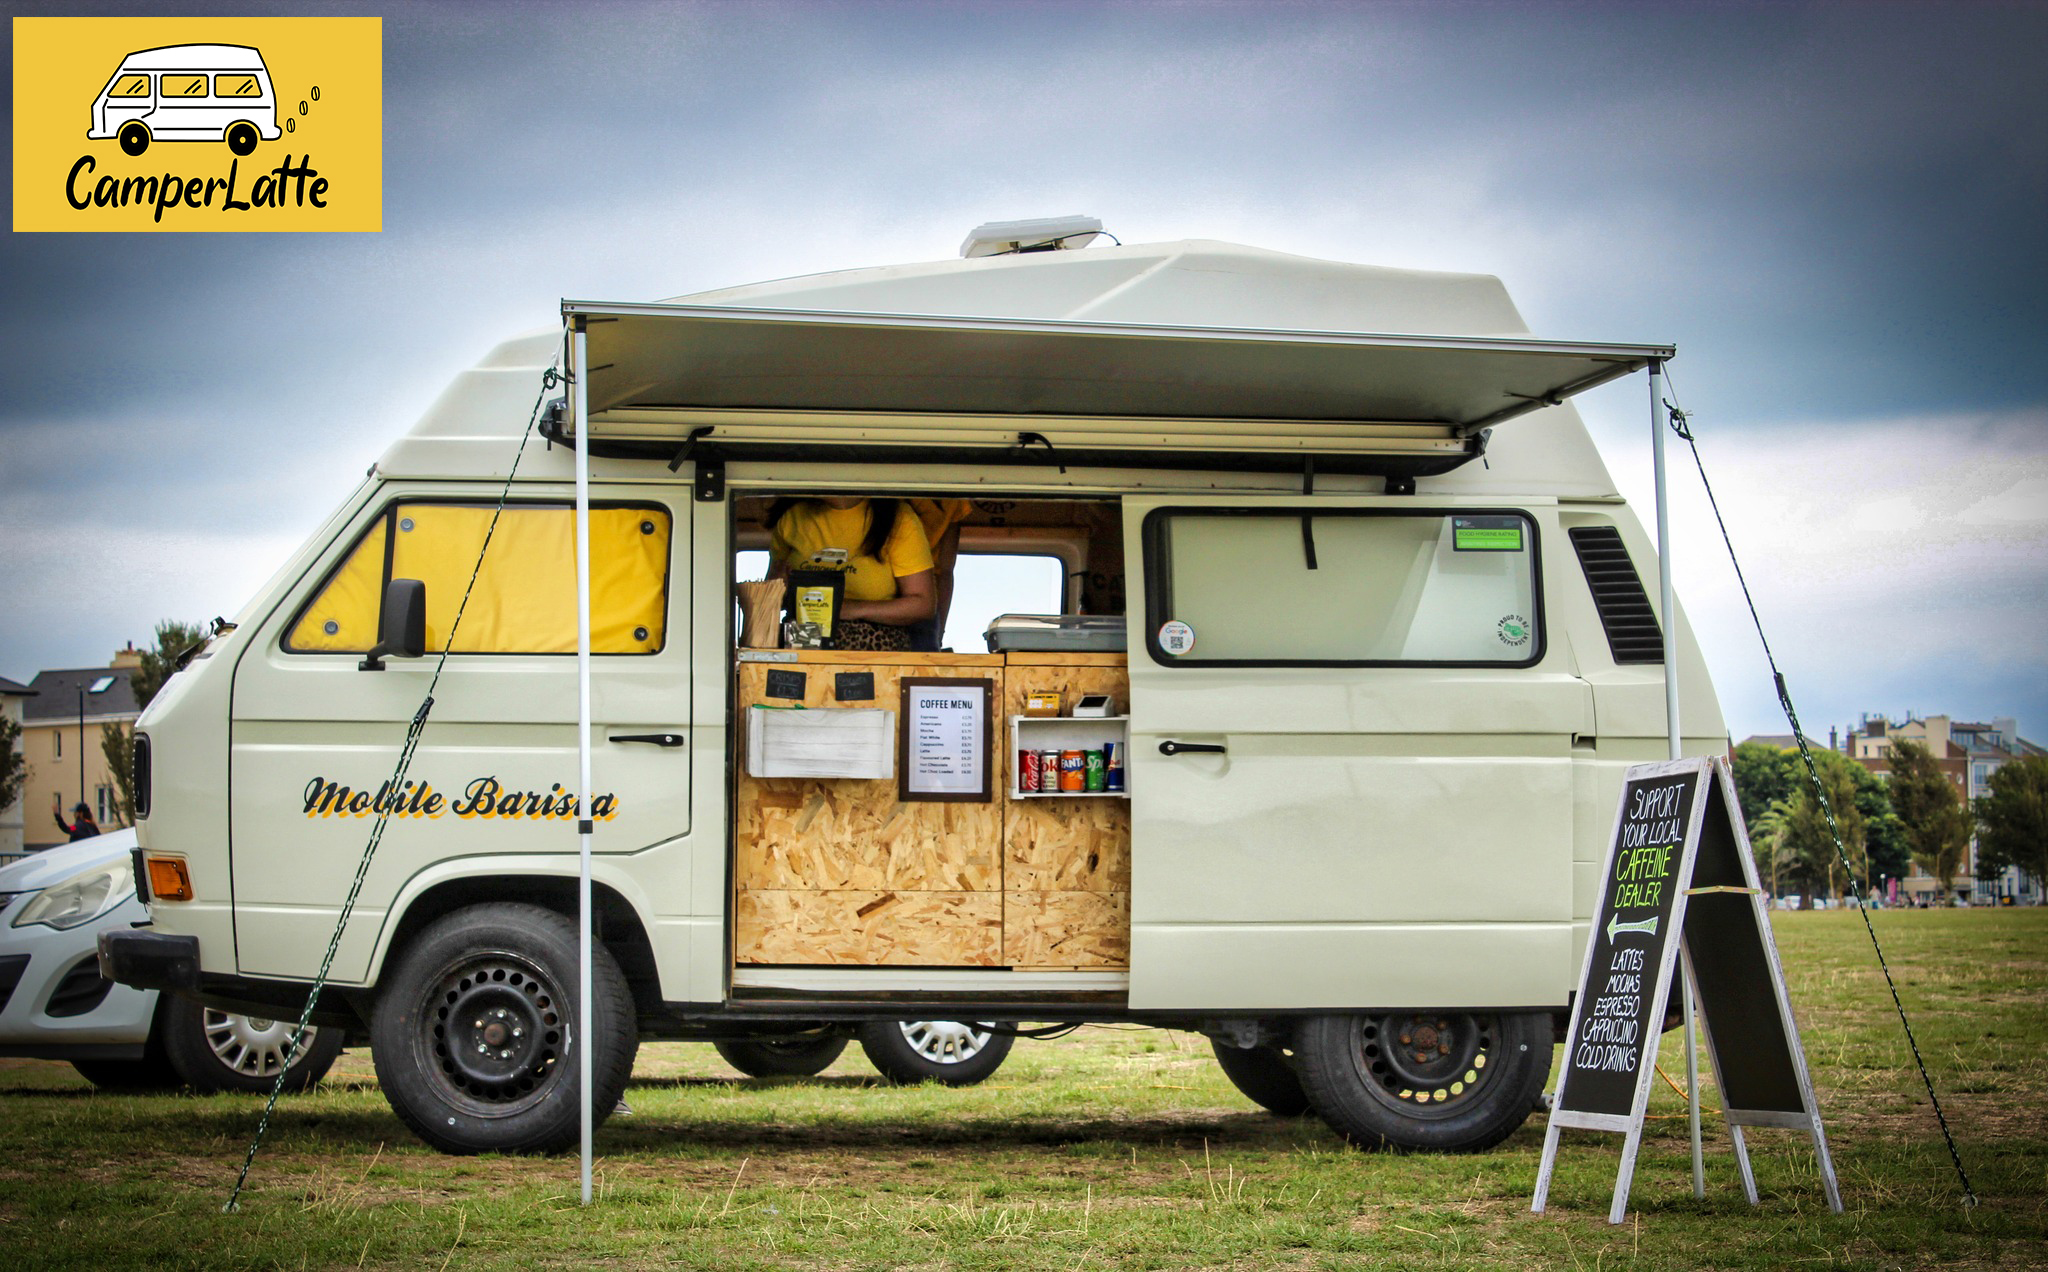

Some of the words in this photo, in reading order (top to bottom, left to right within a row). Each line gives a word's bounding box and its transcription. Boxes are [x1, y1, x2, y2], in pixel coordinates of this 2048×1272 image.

[1498, 614, 1514, 628] PROUD
[1497, 630, 1530, 647] INDEPENDENT
[920, 700, 948, 709] COFFEE
[950, 700, 973, 709] MENU
[303, 776, 447, 818] Mobile
[1630, 783, 1685, 820] SUPPORT
[1622, 822, 1648, 848] YOUR
[1648, 818, 1682, 845] LOCAL
[1616, 845, 1674, 881] CAFFEINE
[1614, 881, 1662, 908] DEALER
[1611, 948, 1644, 972] LATTES
[1605, 973, 1640, 994] MOCHAS
[1594, 995, 1640, 1017] ESPRESSO
[1582, 1018, 1638, 1044] CAPPUCCINO
[1576, 1042, 1604, 1070] COLD
[1602, 1045, 1636, 1072] DRINKS
